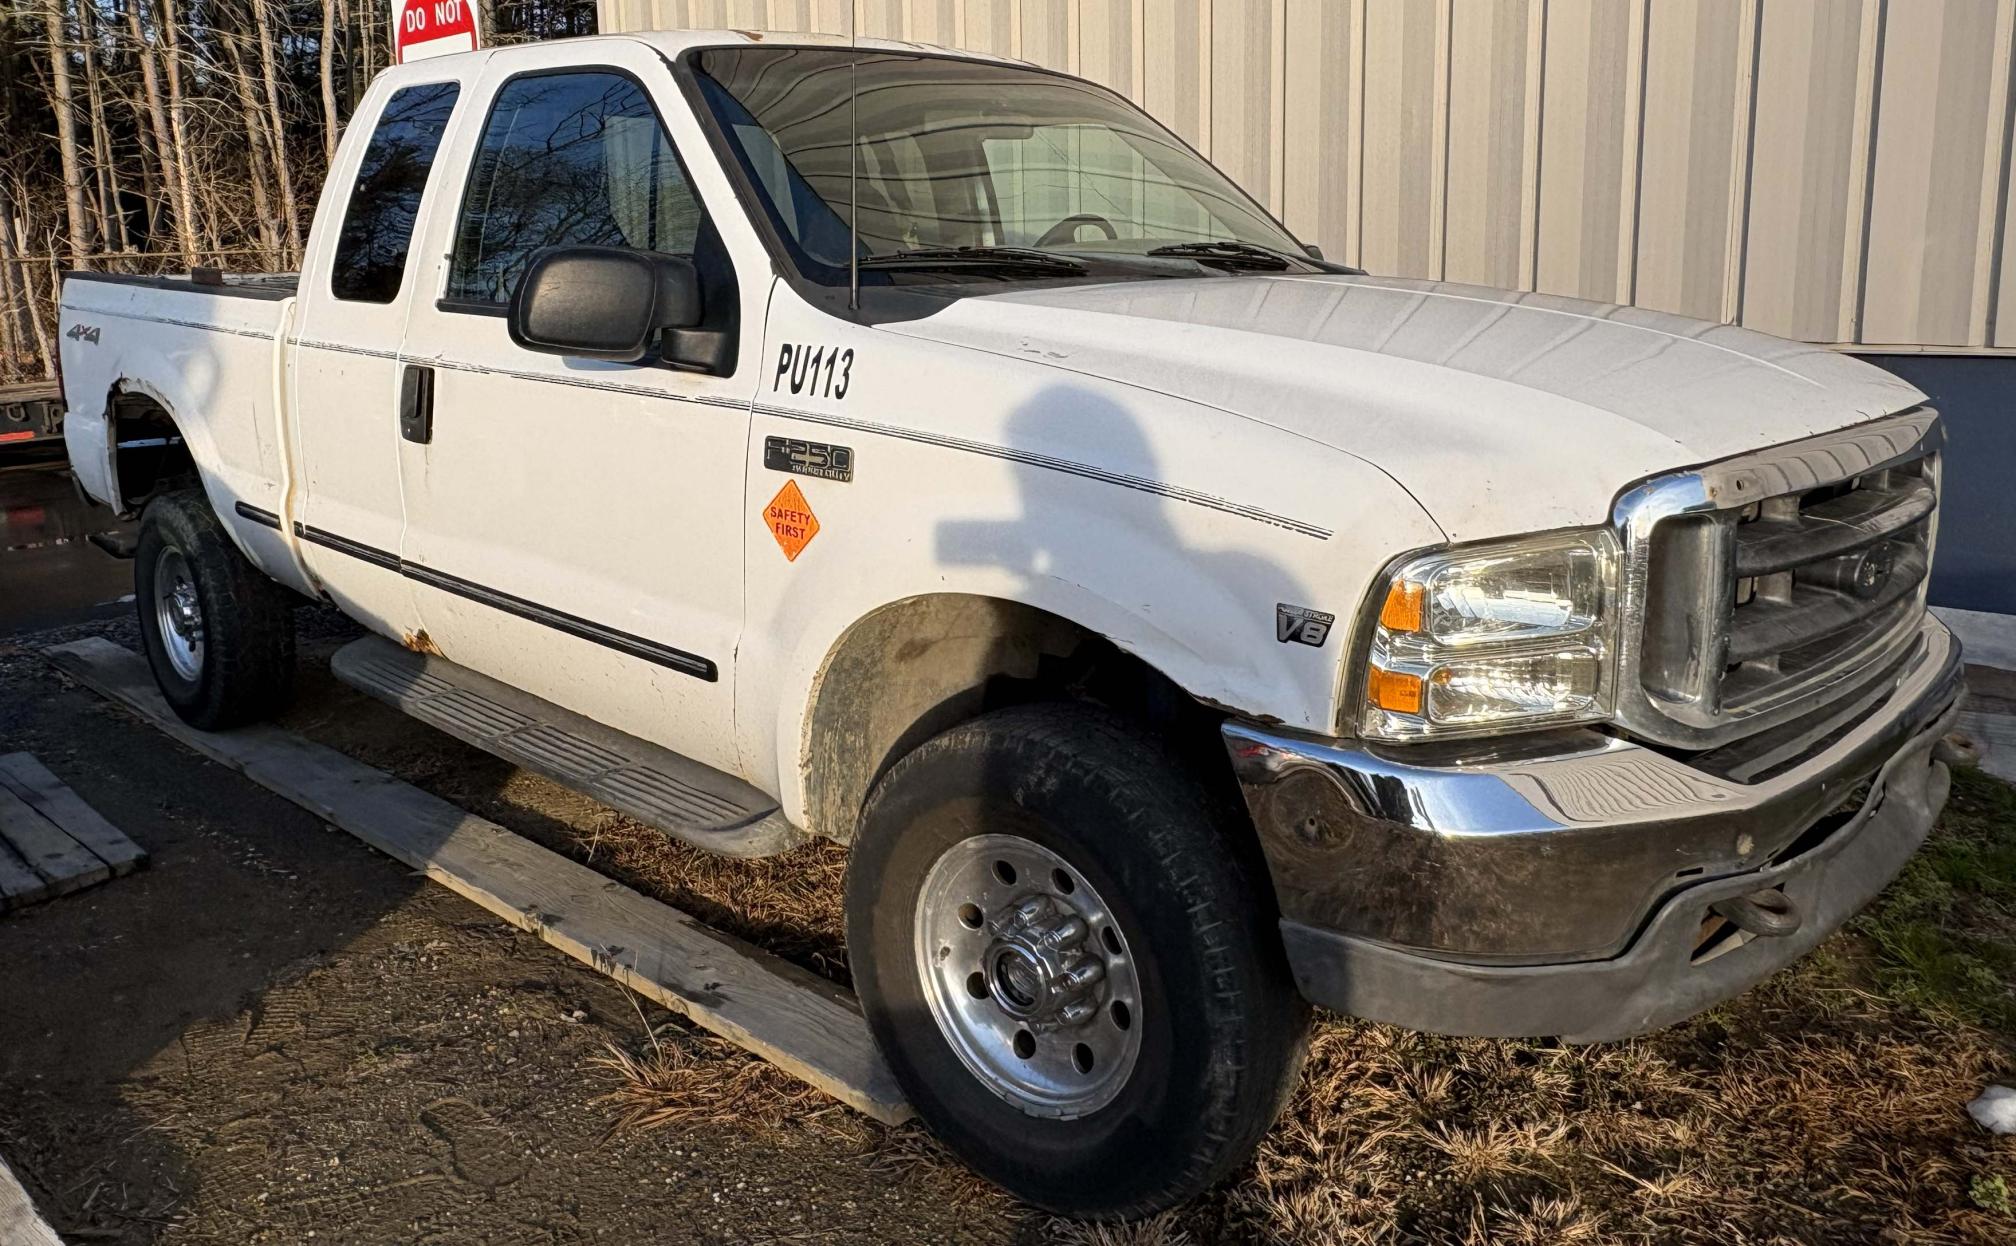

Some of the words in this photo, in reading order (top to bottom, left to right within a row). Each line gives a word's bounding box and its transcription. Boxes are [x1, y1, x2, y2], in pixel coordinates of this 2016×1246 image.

[405, 7, 425, 32] DO
[434, 0, 461, 26] NOT
[773, 343, 853, 399] PU113
[770, 506, 811, 526] SAFETY
[775, 522, 806, 540] FIRST
